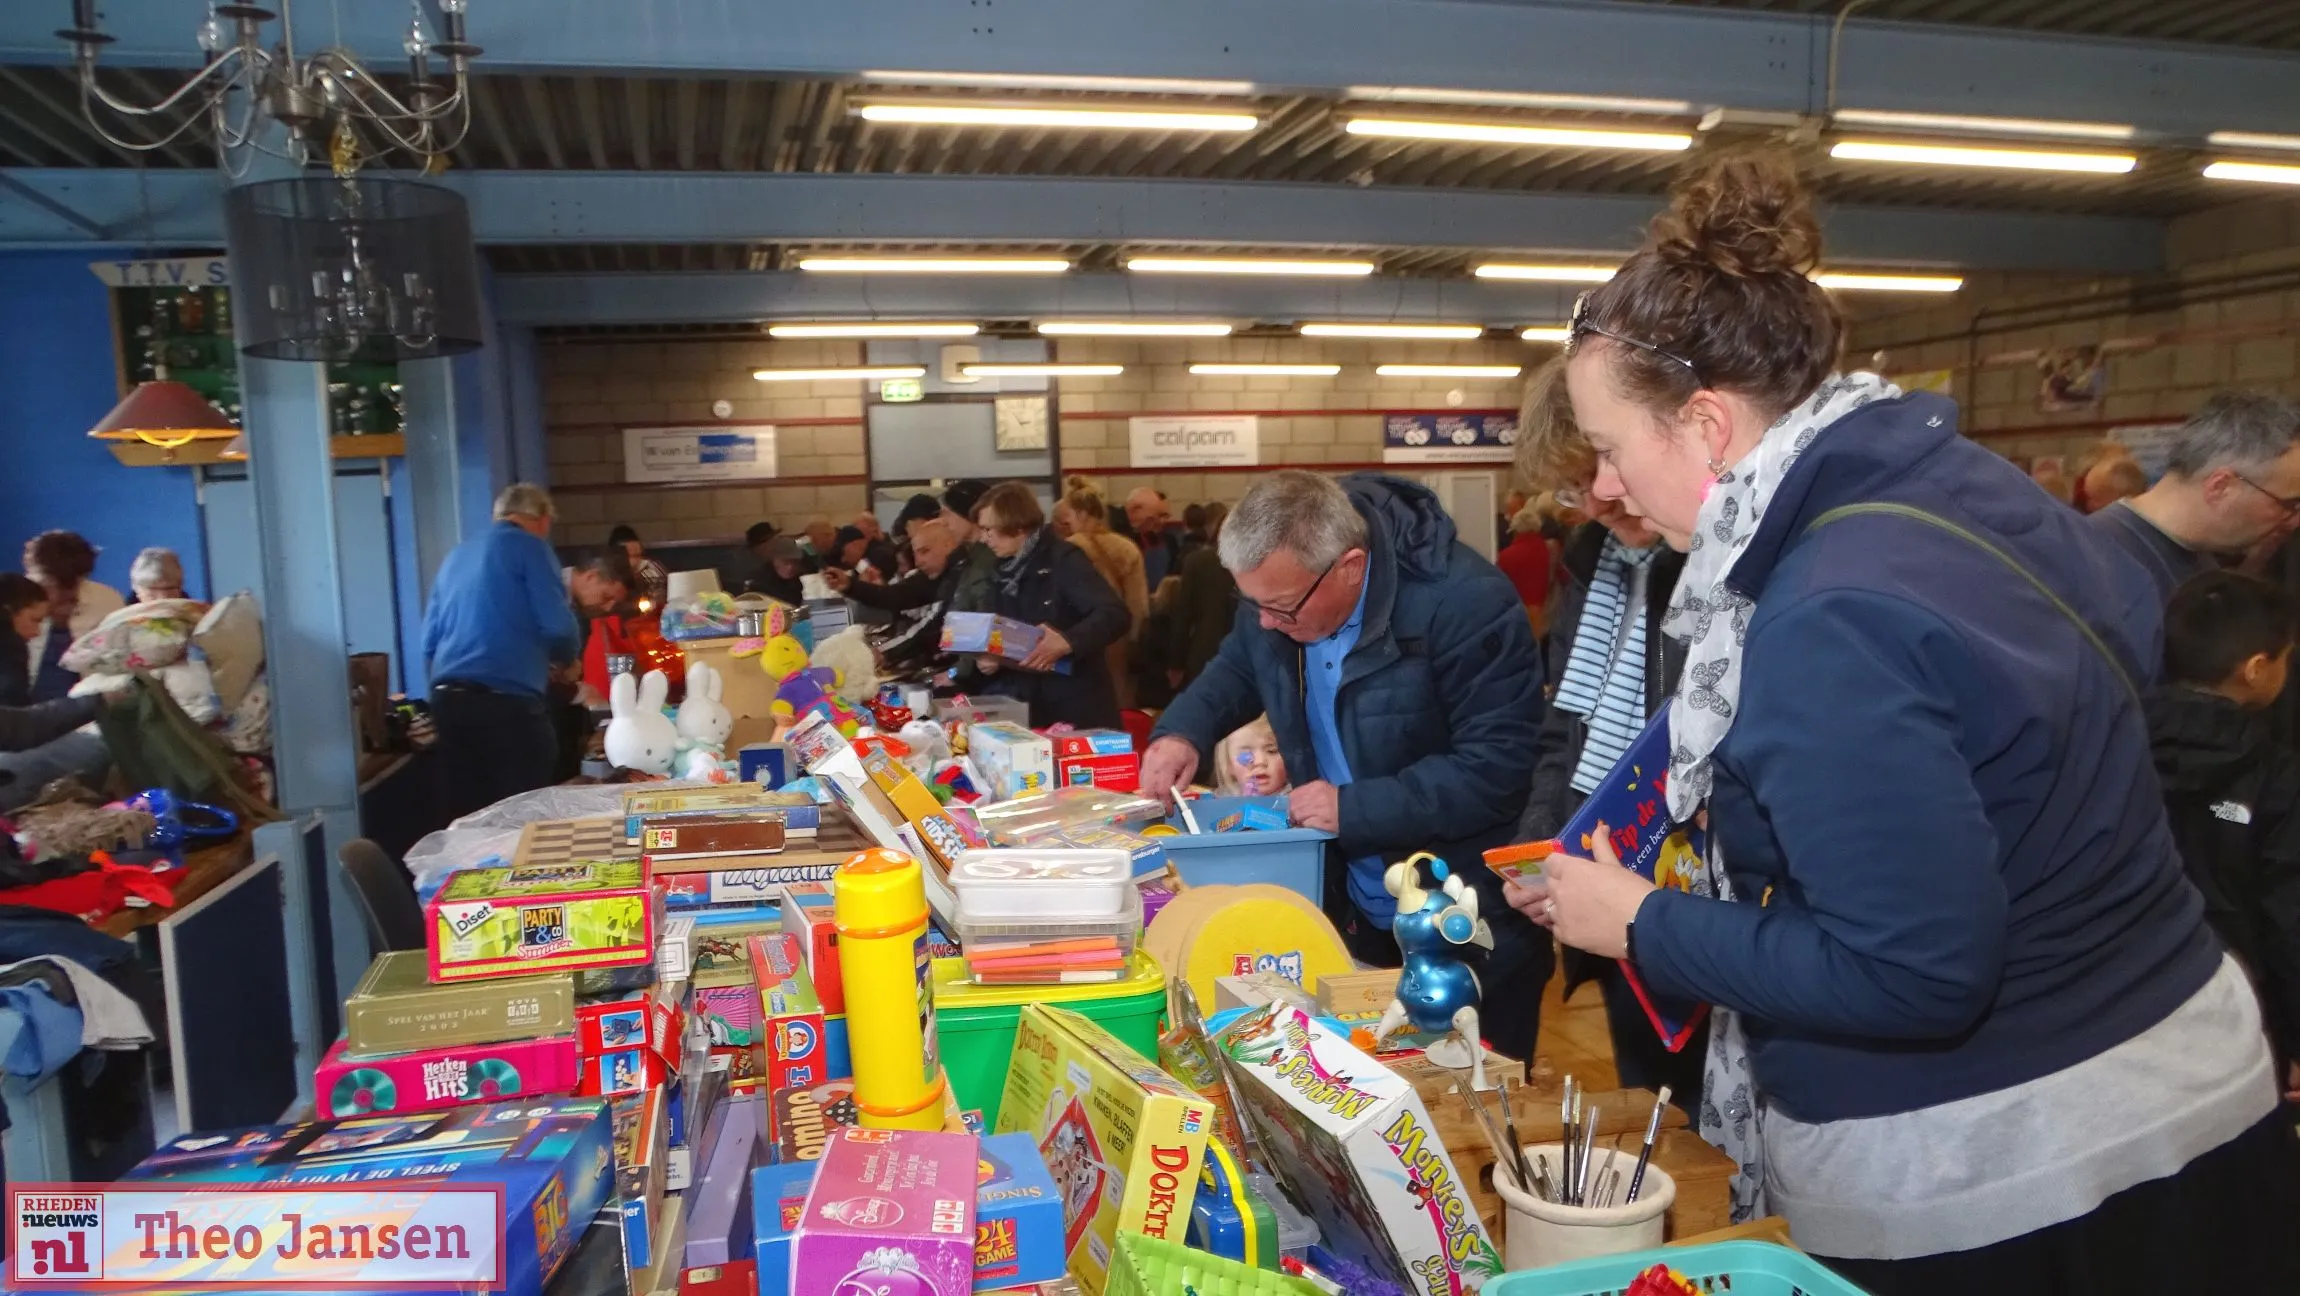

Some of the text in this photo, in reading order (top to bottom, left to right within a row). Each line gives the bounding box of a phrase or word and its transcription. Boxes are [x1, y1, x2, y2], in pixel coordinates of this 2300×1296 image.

[206, 261, 228, 285] S
[1131, 846, 1161, 861] ensburger
[1636, 845, 1653, 864] een
[456, 904, 493, 933] Diset
[523, 907, 562, 929] PARTY
[536, 926, 563, 945] & CO
[421, 1056, 468, 1077] Herken
[782, 1090, 827, 1162] omino
[1184, 1109, 1203, 1134] MB
[332, 1171, 361, 1183] TV
[363, 1167, 396, 1180] DE
[400, 1162, 462, 1177] SPEEL
[1142, 1144, 1190, 1241] DOKTE
[624, 1206, 640, 1218] er
[975, 1217, 1013, 1253] 24
[976, 1243, 1017, 1267] GAME
